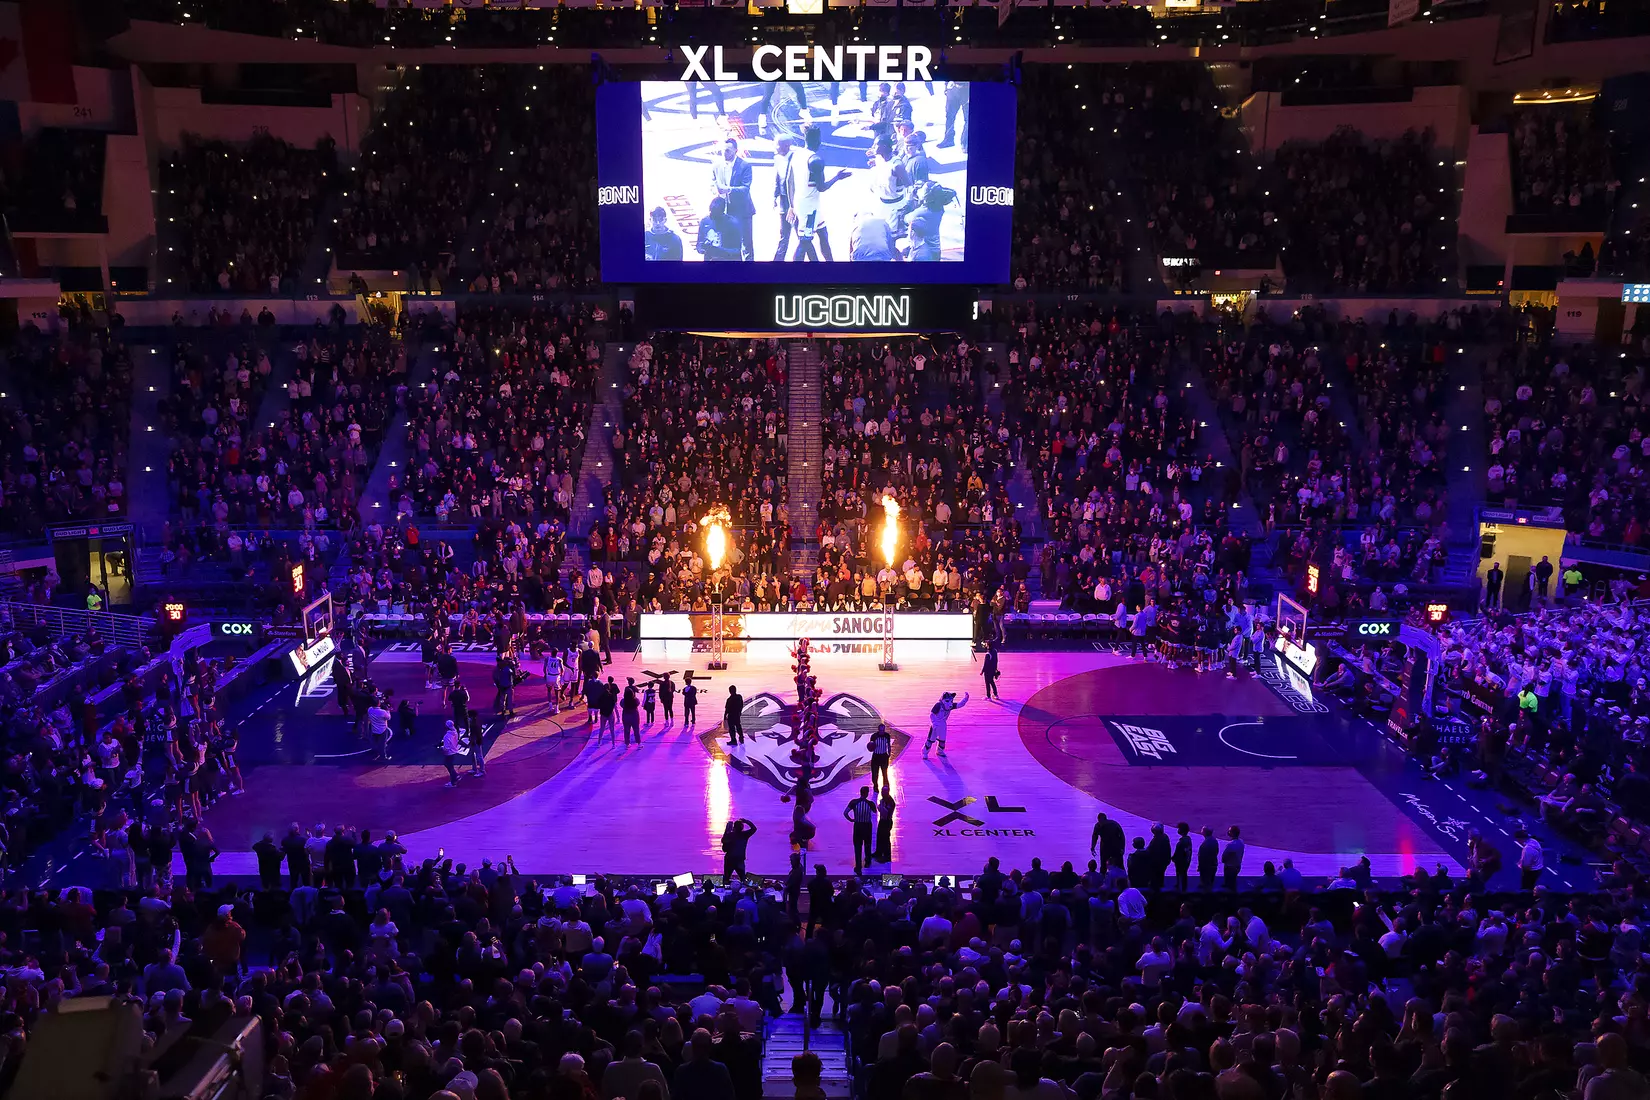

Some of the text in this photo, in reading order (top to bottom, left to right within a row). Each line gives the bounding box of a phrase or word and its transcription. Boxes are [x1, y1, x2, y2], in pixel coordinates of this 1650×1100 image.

[679, 44, 933, 81] XL CENTER
[775, 295, 910, 327] UCONN
[1567, 310, 1582, 318] 119
[165, 603, 184, 611] 20:00
[170, 611, 181, 620] 30
[1430, 612, 1442, 621] 30
[222, 623, 253, 634] COX
[832, 617, 894, 634] SANOGO
[1359, 623, 1390, 635] COX
[1432, 724, 1470, 734] HAELS
[1122, 723, 1163, 760] EAST
[1145, 727, 1178, 754] BIG
[926, 795, 1027, 828] XL
[932, 829, 1036, 837] XL CENTER
